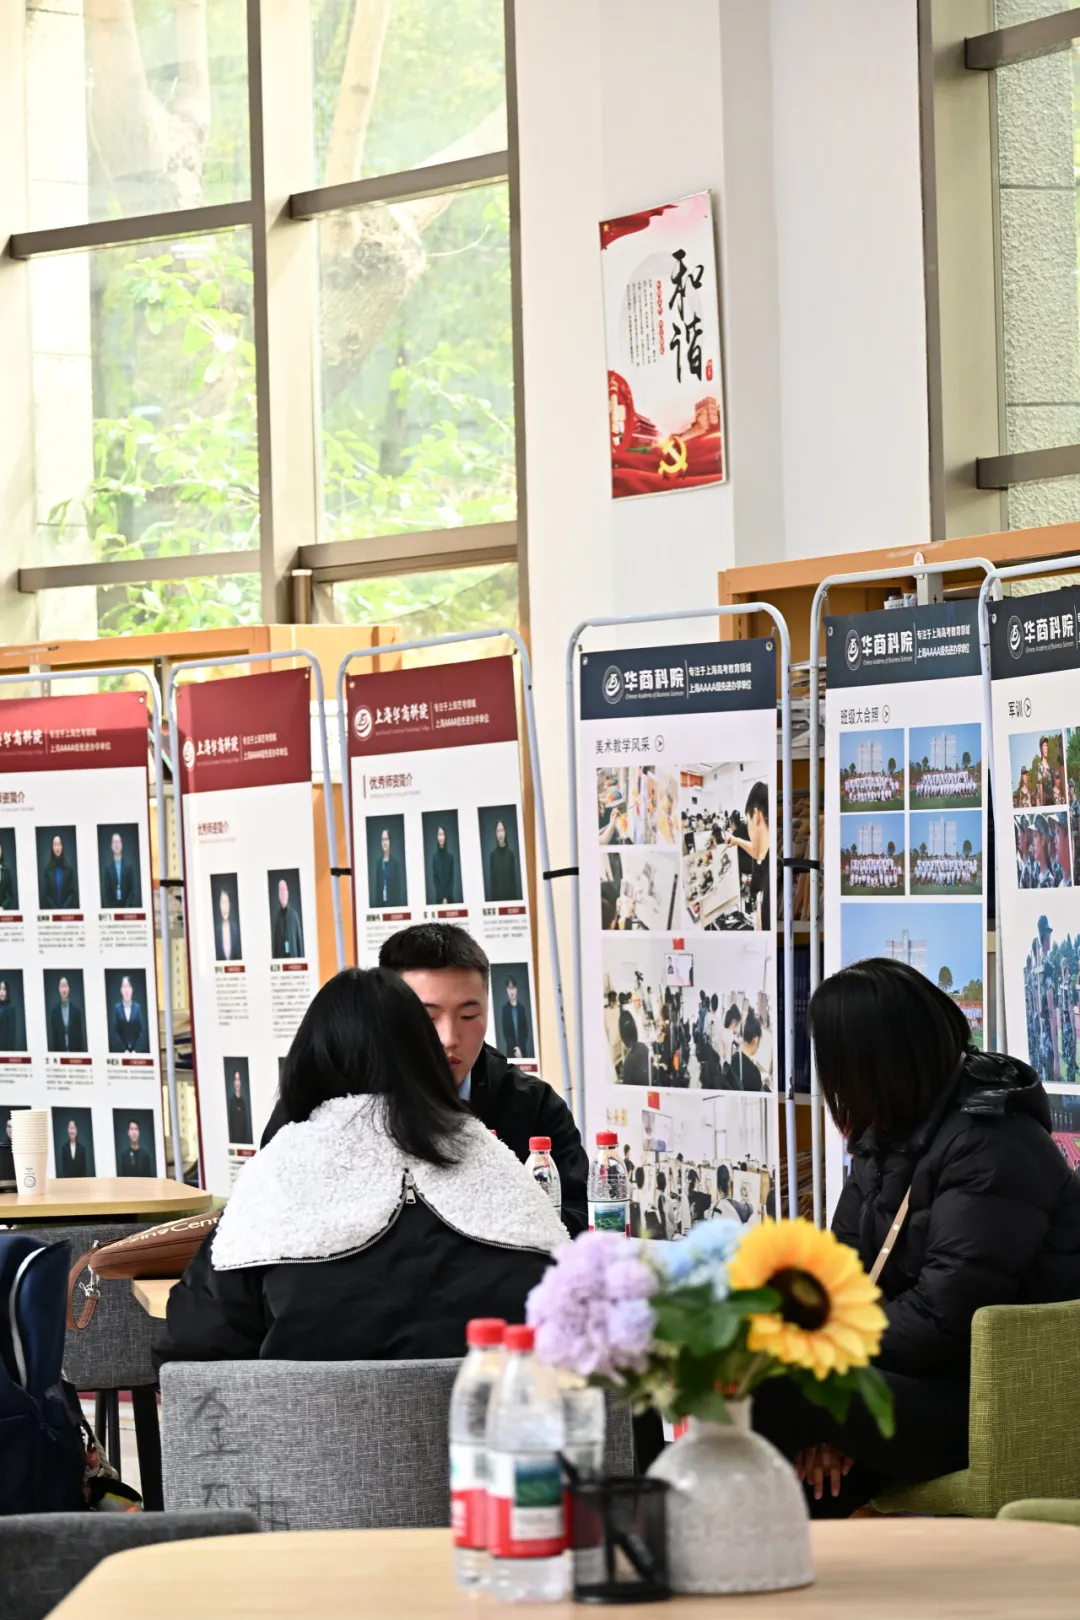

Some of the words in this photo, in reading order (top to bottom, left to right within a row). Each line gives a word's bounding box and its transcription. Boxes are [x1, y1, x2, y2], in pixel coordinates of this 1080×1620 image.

[669, 249, 704, 383] 和谐
[1024, 613, 1074, 644] 华商科院
[861, 630, 913, 657] 华商科院
[623, 667, 684, 691] 华商科院
[840, 706, 879, 725] 班级大合照
[1008, 700, 1023, 719] 军训
[595, 737, 650, 754] 美术教学风采
